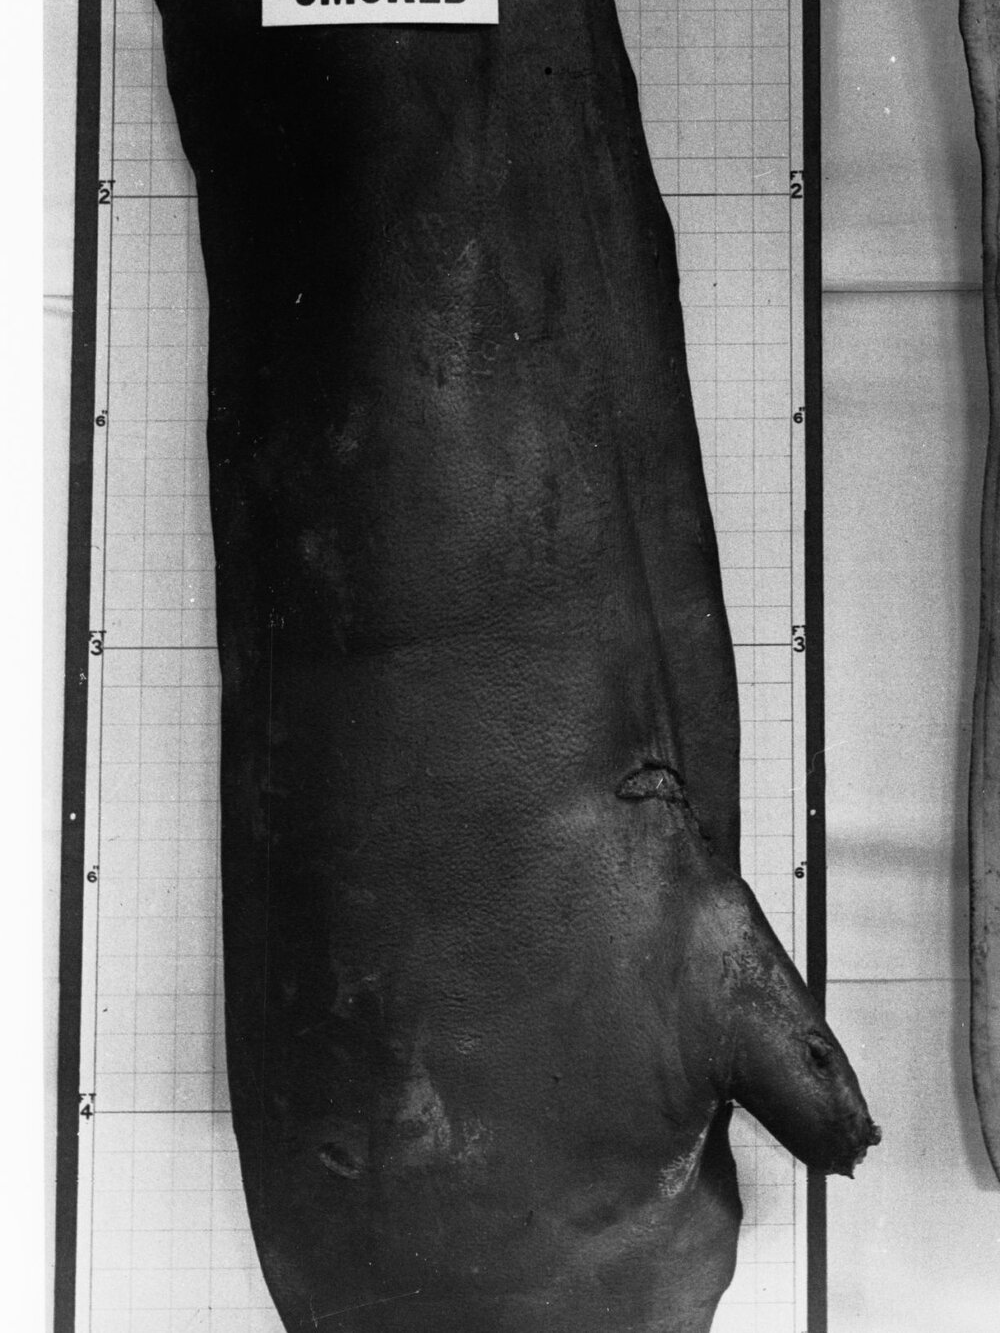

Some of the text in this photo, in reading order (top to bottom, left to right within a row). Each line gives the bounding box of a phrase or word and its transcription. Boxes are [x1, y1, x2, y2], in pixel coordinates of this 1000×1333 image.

[98, 189, 111, 205] 2
[790, 183, 803, 199] 2
[90, 639, 104, 656] 3
[793, 636, 806, 653] 3
[80, 1104, 93, 1120] 4
